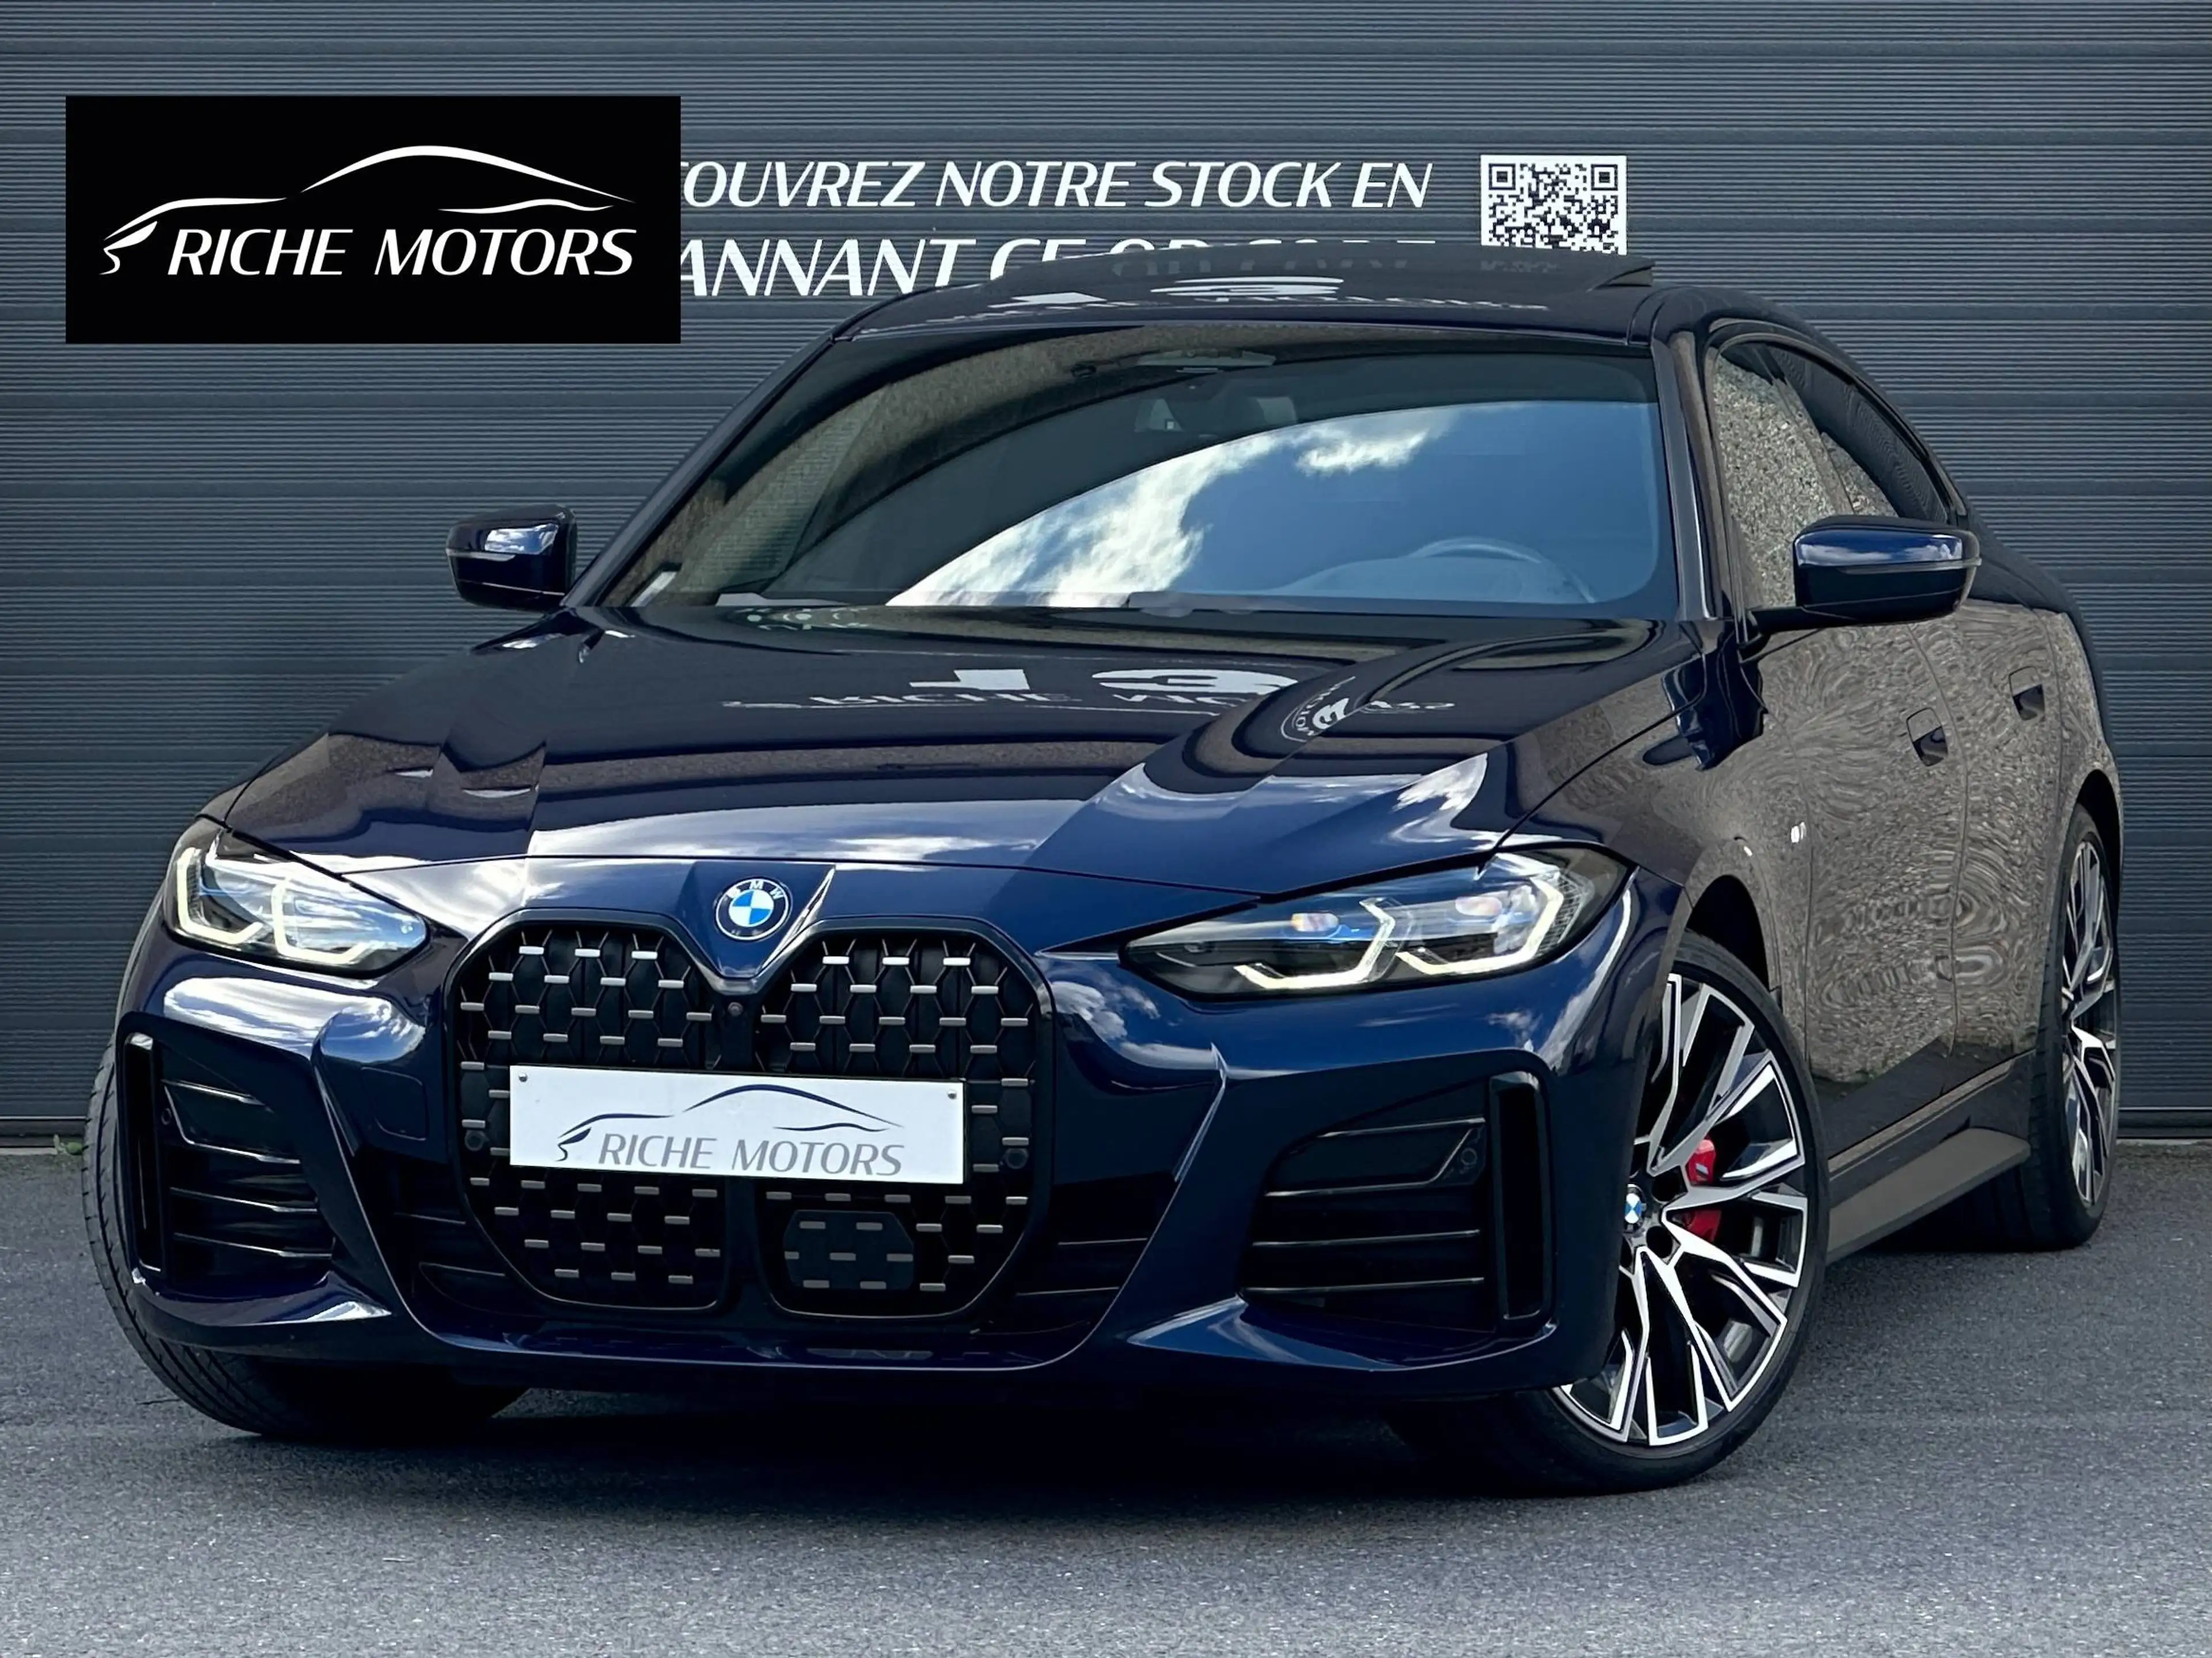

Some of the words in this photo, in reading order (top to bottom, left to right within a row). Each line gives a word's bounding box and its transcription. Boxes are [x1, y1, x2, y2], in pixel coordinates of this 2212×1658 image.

[681, 162, 925, 207] OUVREZ
[936, 161, 1136, 206] NOTRE
[1145, 162, 1341, 207] STOCK
[1352, 163, 1432, 207] EN
[681, 240, 976, 295] ANNANT
[599, 1133, 717, 1168] RICHE
[732, 1140, 904, 1175] MOTORS
